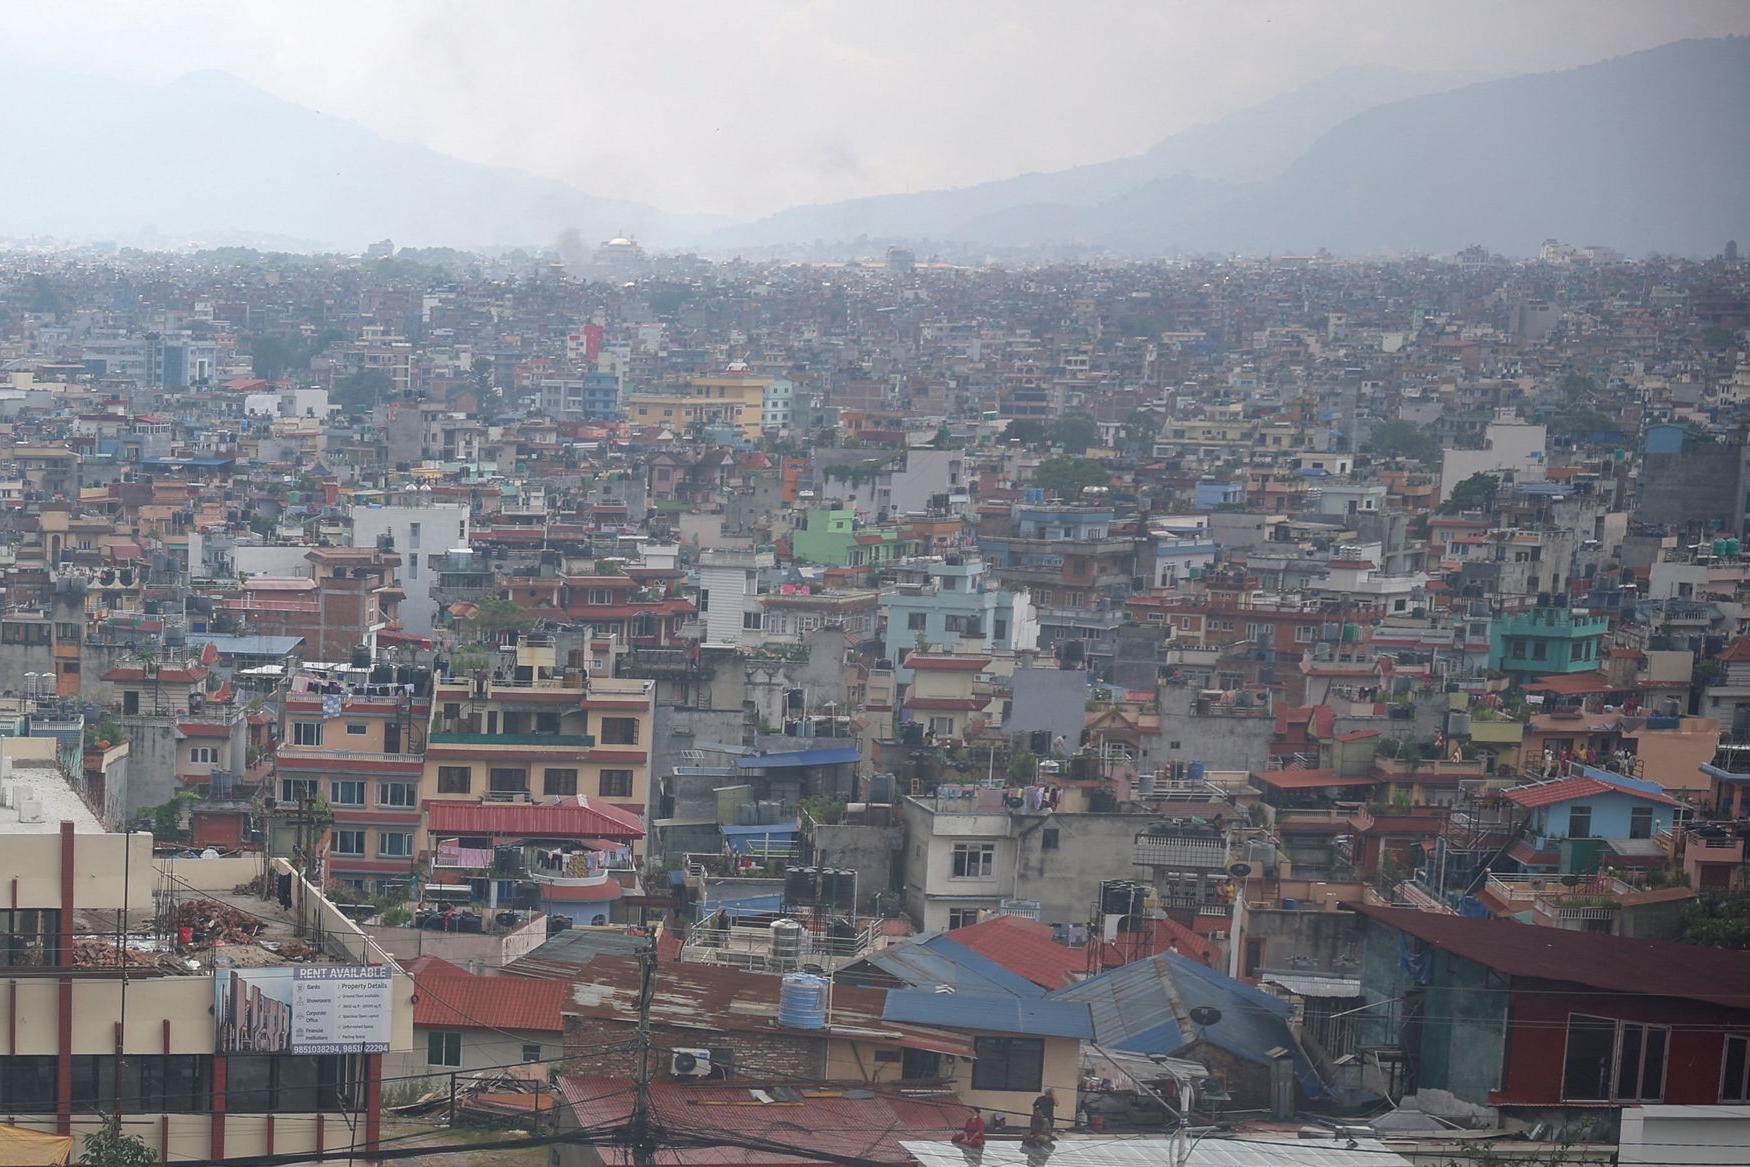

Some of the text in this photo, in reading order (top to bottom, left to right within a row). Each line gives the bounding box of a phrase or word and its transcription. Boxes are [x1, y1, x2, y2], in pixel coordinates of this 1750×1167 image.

[299, 967, 386, 979] RENT AVAILABLE
[293, 1044, 341, 1054] 9851038294,
